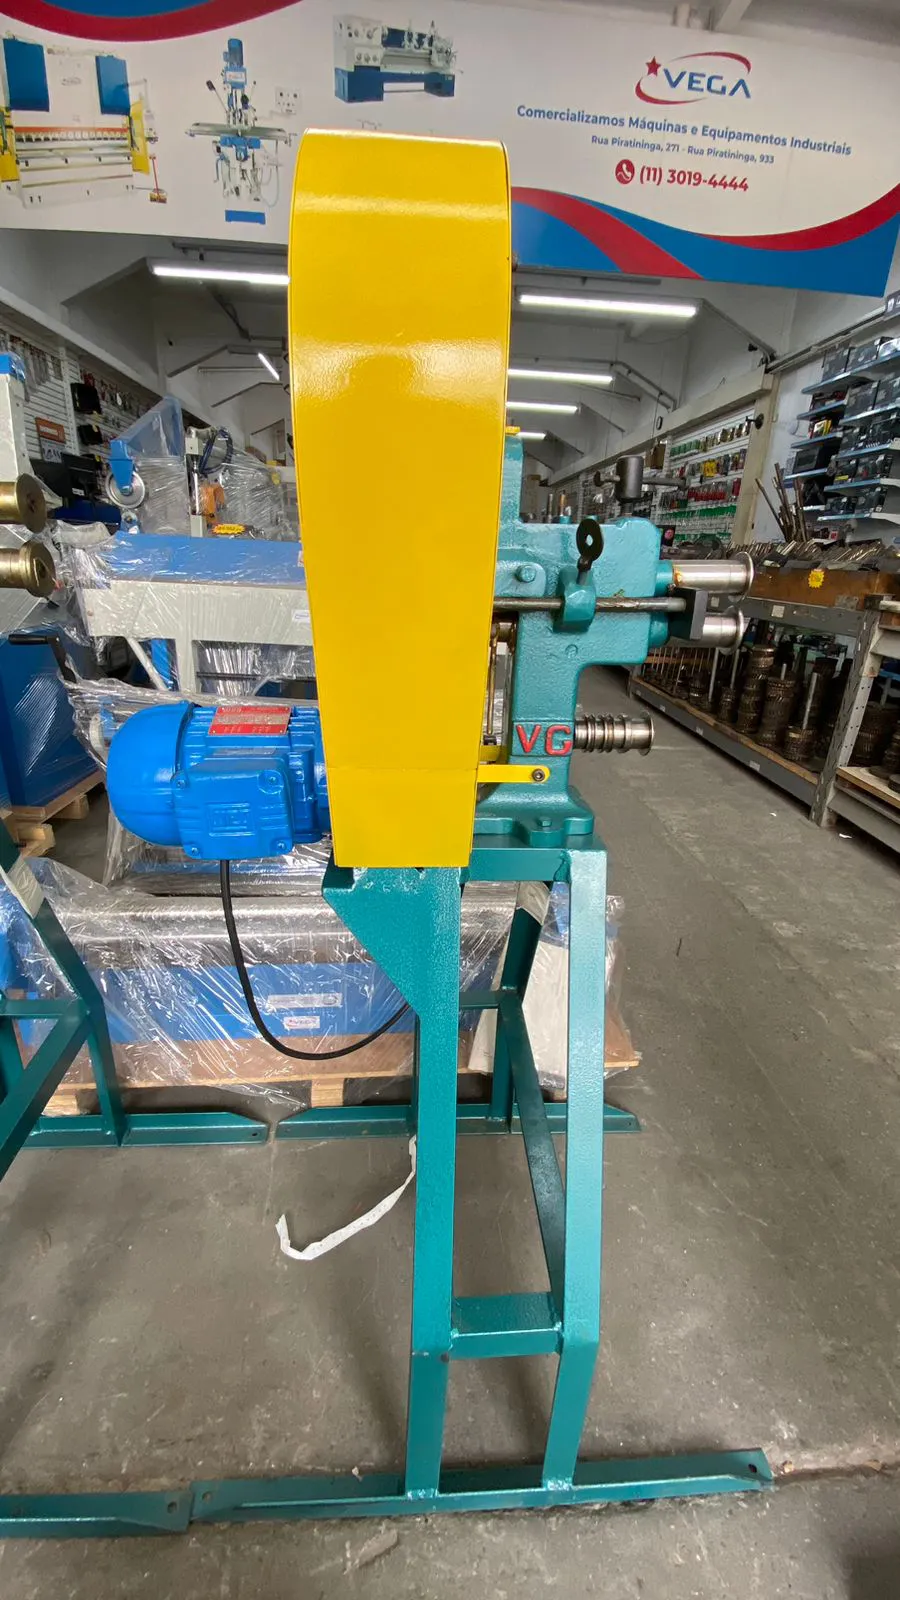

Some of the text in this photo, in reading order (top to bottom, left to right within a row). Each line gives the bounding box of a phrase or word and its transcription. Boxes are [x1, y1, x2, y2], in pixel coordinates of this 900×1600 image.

[663, 68, 751, 99] VEGA
[517, 105, 852, 155] Comercializamos Máquinas e Equipamentos Industriais
[592, 135, 609, 145] Rua
[611, 137, 664, 152] Piratininga,
[666, 142, 680, 153] 271
[687, 145, 704, 156] Rua
[707, 148, 757, 163] Piratininga,
[759, 154, 774, 164] 933
[640, 165, 749, 192] (11) 3019-4444
[516, 724, 573, 756] VG
